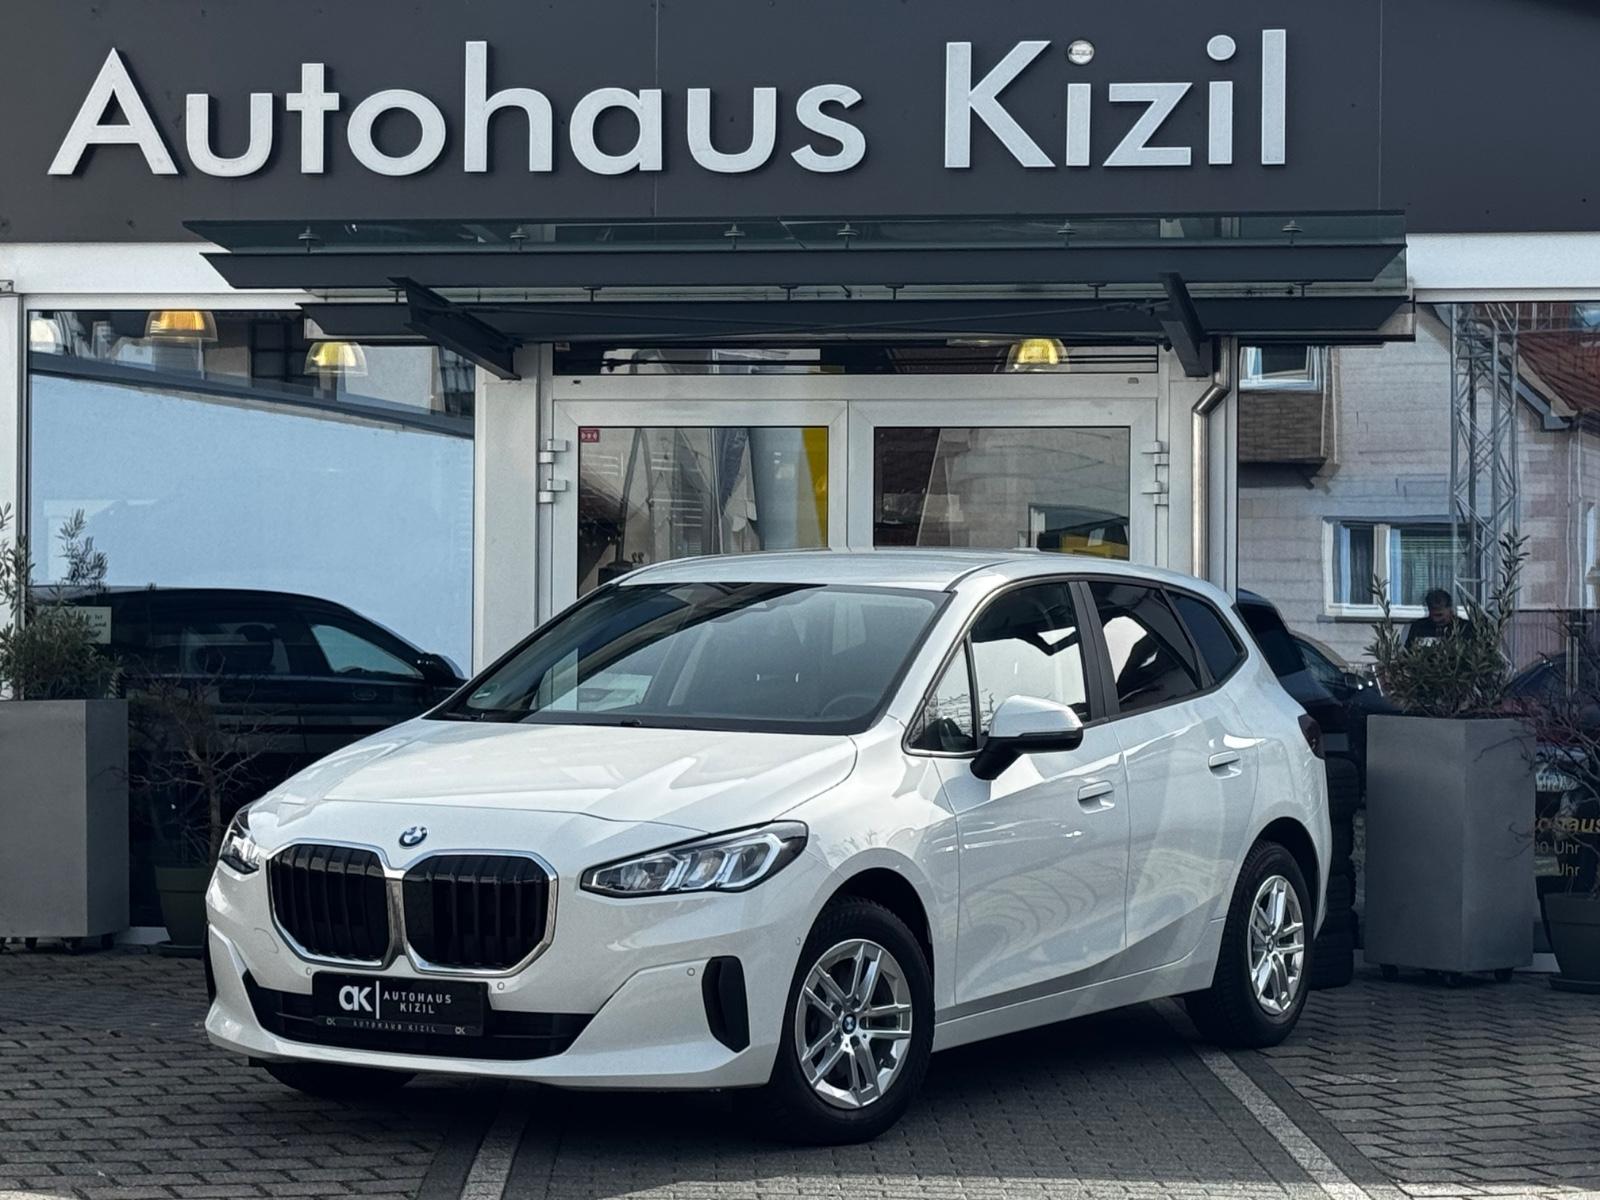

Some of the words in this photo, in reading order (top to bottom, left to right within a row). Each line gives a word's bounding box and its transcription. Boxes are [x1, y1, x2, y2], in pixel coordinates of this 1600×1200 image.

[48, 40, 866, 176] Autohaus
[944, 29, 1287, 168] Kizil
[1554, 840, 1580, 855] Uhr
[383, 991, 452, 1004] AUTOHAUS
[400, 1002, 435, 1014] KIZIL
